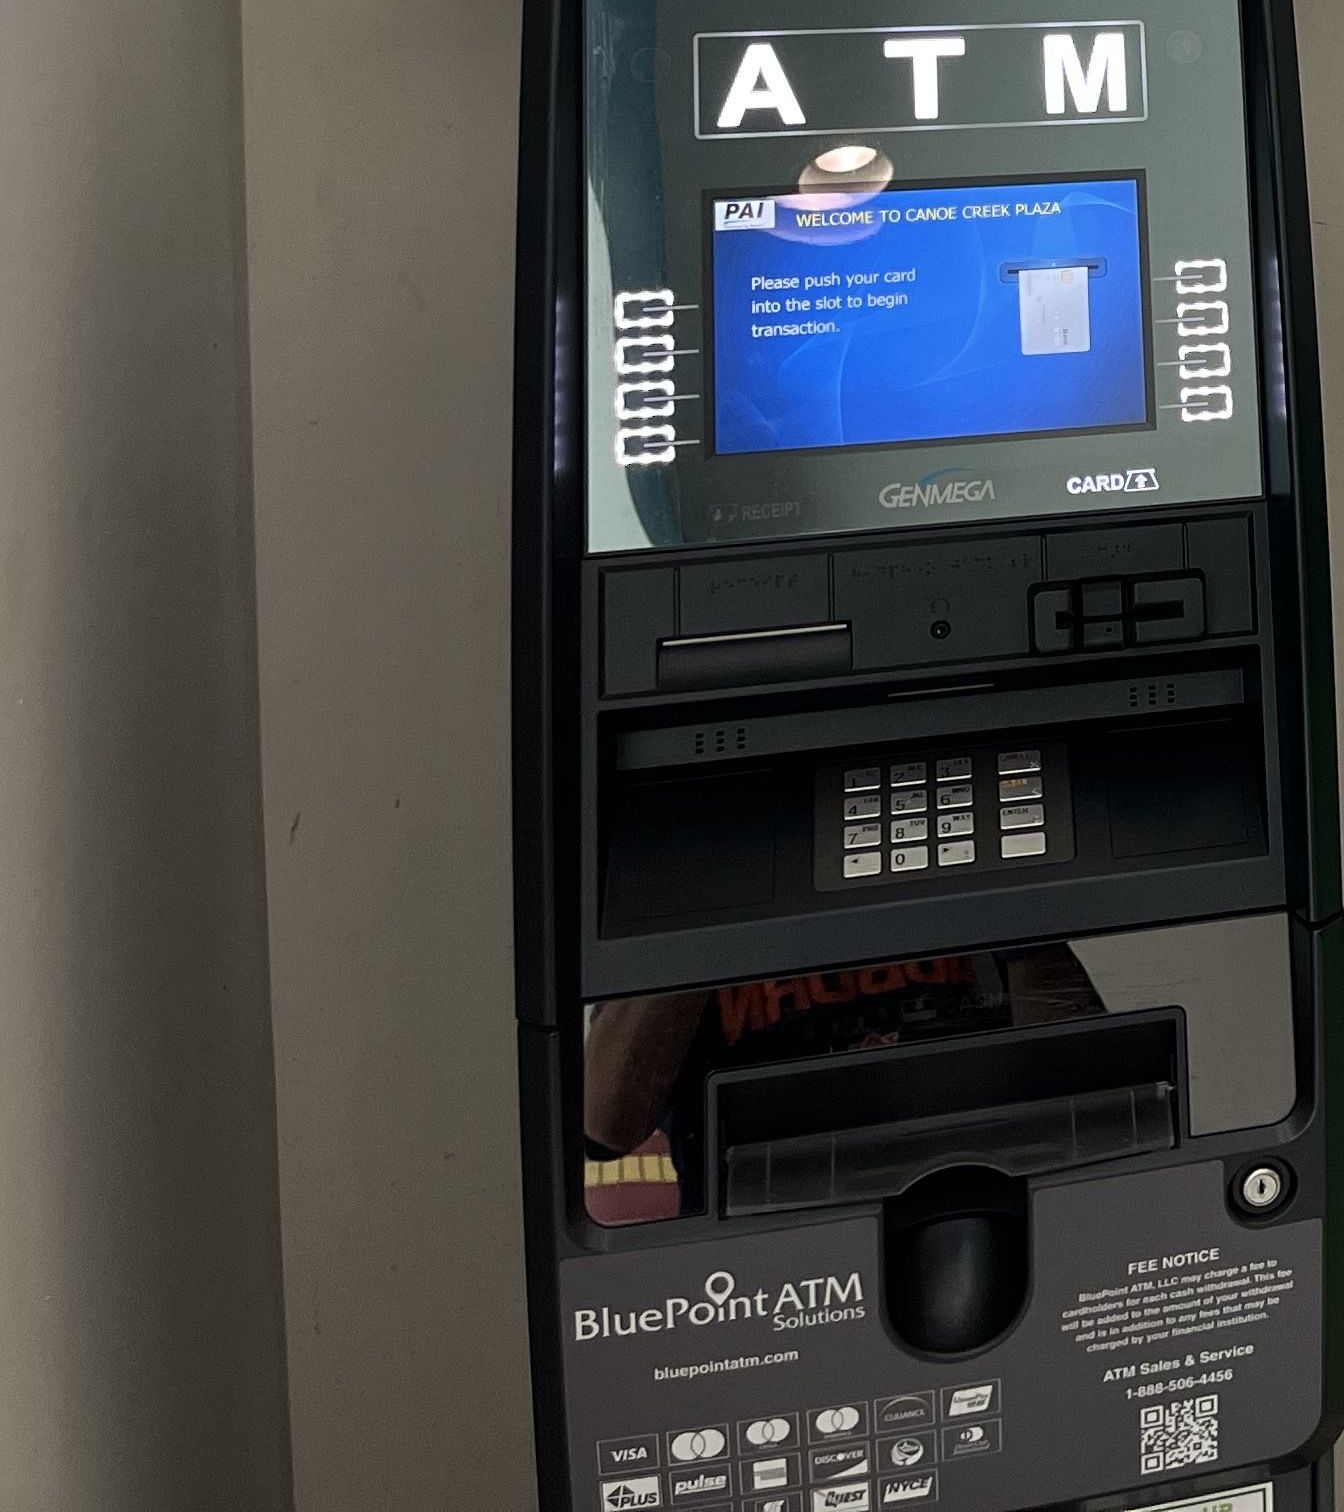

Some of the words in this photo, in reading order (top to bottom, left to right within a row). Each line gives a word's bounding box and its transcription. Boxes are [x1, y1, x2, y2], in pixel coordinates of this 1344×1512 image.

[724, 202, 765, 221] PAI
[796, 212, 873, 228] WELCOME
[879, 210, 900, 224] TO
[905, 207, 957, 222] CANOE
[962, 204, 1010, 219] CREEK
[1015, 201, 1062, 217] PLAZA
[751, 275, 800, 291] Please
[804, 272, 841, 291] push
[845, 273, 879, 287] your
[883, 268, 916, 283] card
[751, 298, 781, 314] into
[785, 296, 811, 312] the
[815, 295, 842, 310] slot
[847, 296, 863, 308] to
[867, 292, 908, 310] begin
[751, 319, 840, 338] transaction.
[879, 481, 994, 509] GENMEGA
[1067, 473, 1125, 495] CARD
[741, 501, 800, 521] RECEIPT
[850, 777, 859, 788] 1
[895, 772, 905, 784] 2
[941, 766, 950, 778] 3
[847, 804, 858, 817] 4
[895, 800, 905, 811] 5
[940, 794, 951, 806] 6
[848, 833, 858, 845] 7
[895, 827, 905, 839] 8
[941, 822, 952, 834] 9
[1129, 1259, 1157, 1274] FEE
[1163, 1248, 1219, 1268] NOTICE
[1063, 1302, 1123, 1317] cardholders
[1143, 1293, 1167, 1303] each
[1170, 1288, 1193, 1298] cash
[1197, 1277, 1251, 1292] withdrawal.
[1255, 1273, 1274, 1282] This
[1080, 1287, 1128, 1301] BluePoint
[1131, 1282, 1155, 1293] ATM,
[1159, 1277, 1177, 1288] LLC
[1182, 1275, 1201, 1283] may
[1205, 1268, 1238, 1279] charge
[575, 1274, 769, 1341] BluePoint
[773, 1272, 863, 1315] ATM
[1062, 1321, 1078, 1330] will
[1098, 1312, 1128, 1324] added
[1163, 1299, 1200, 1312] amount
[1204, 1296, 1213, 1304] of
[1217, 1293, 1238, 1304] your
[1242, 1281, 1292, 1297] withdrawal
[773, 1304, 866, 1332] Solutions
[1076, 1331, 1095, 1341] and
[1122, 1320, 1163, 1332] addition
[1179, 1314, 1196, 1322] any
[1224, 1304, 1241, 1313] that
[1245, 1301, 1264, 1309] may
[1087, 1338, 1128, 1352] charged
[1132, 1336, 1143, 1344] by
[1147, 1332, 1169, 1342] your
[1173, 1321, 1213, 1336] financial
[1218, 1313, 1268, 1327] institution.
[654, 1350, 799, 1380] bluepointatm.com
[1104, 1366, 1135, 1382] ATM
[1141, 1360, 1179, 1374] Sales
[1185, 1355, 1194, 1366] &
[1201, 1346, 1253, 1363] Service
[1127, 1369, 1232, 1399] 1-888-506-4456
[610, 1447, 648, 1462] VISA
[814, 1449, 864, 1465] DISCOVER
[674, 1474, 727, 1496] pulse
[887, 1476, 932, 1494] NYCE
[619, 1491, 658, 1509] PLUS
